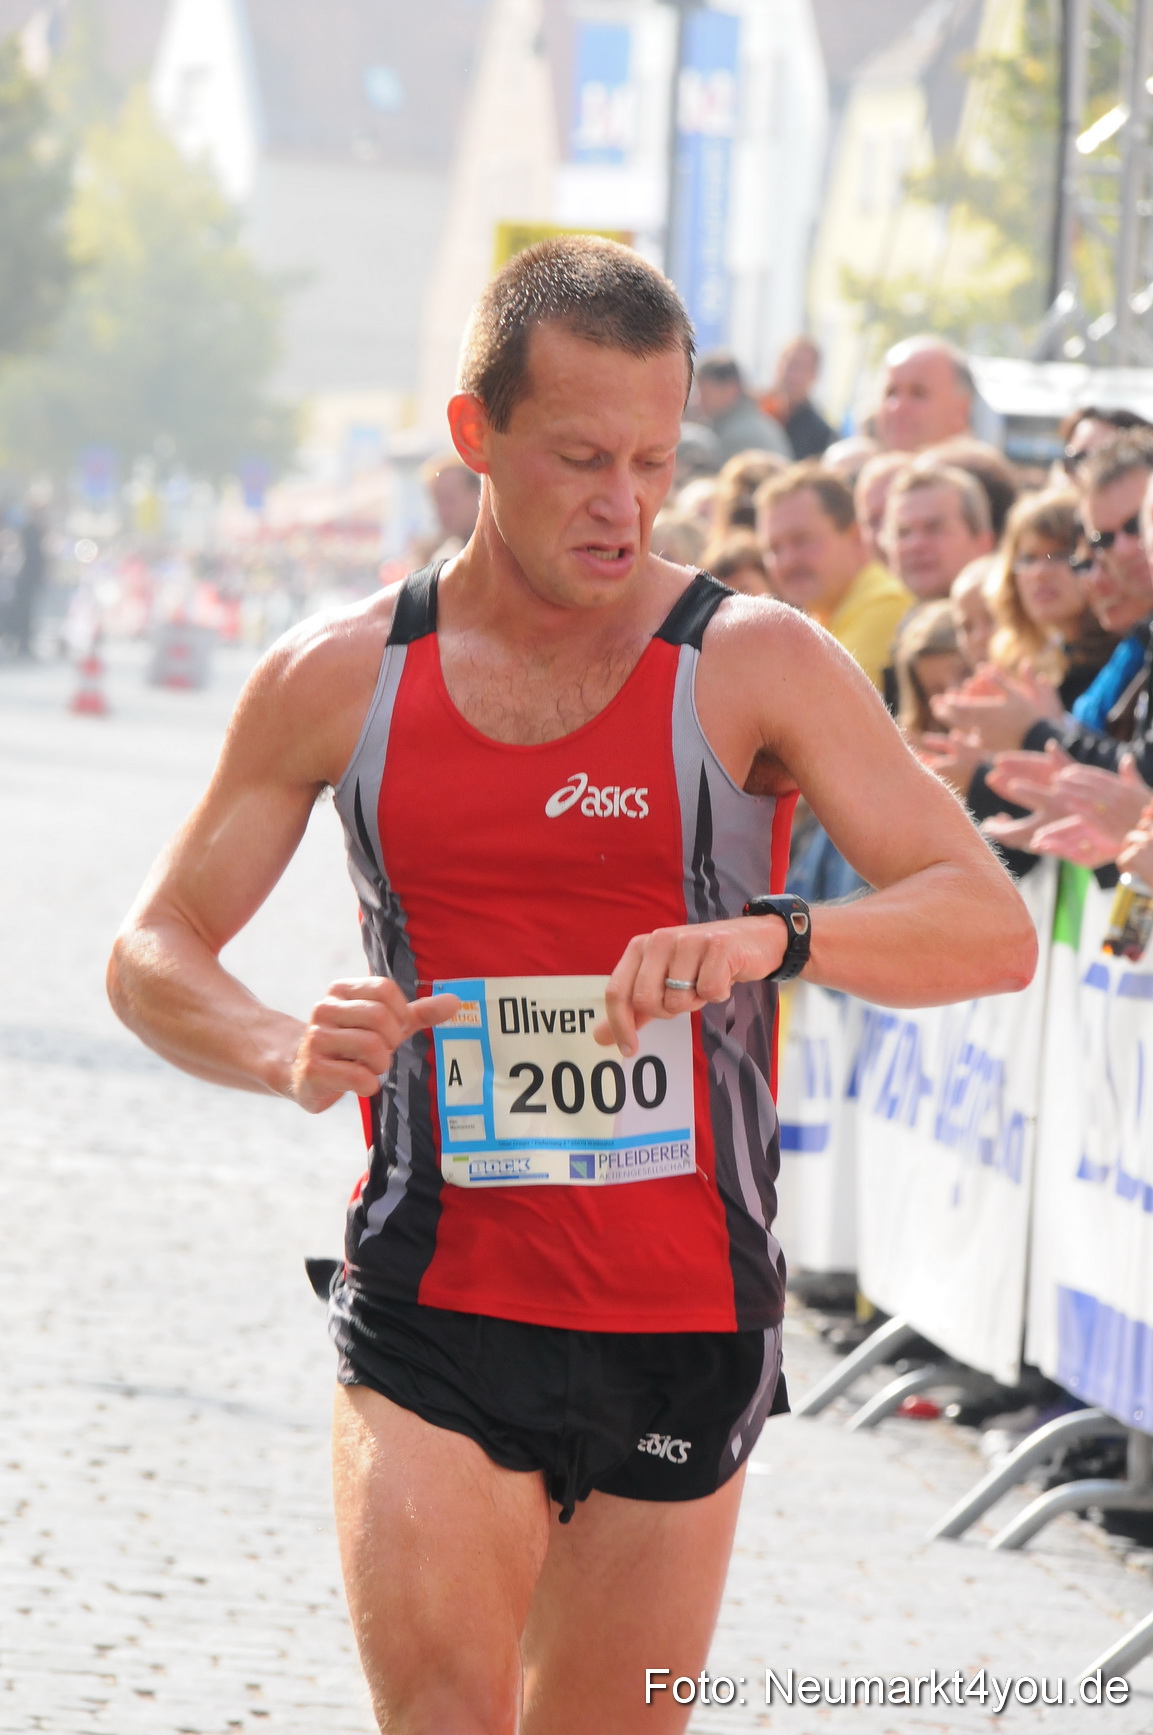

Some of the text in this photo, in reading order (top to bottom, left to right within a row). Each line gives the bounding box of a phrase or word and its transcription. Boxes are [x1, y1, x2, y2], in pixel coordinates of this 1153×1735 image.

[580, 785, 649, 819] asics
[498, 995, 596, 1035] Oliver
[447, 1058, 463, 1087] A
[508, 1054, 668, 1115] 2000
[468, 1157, 531, 1175] BOCK
[598, 1142, 690, 1169] PFLEIDERER
